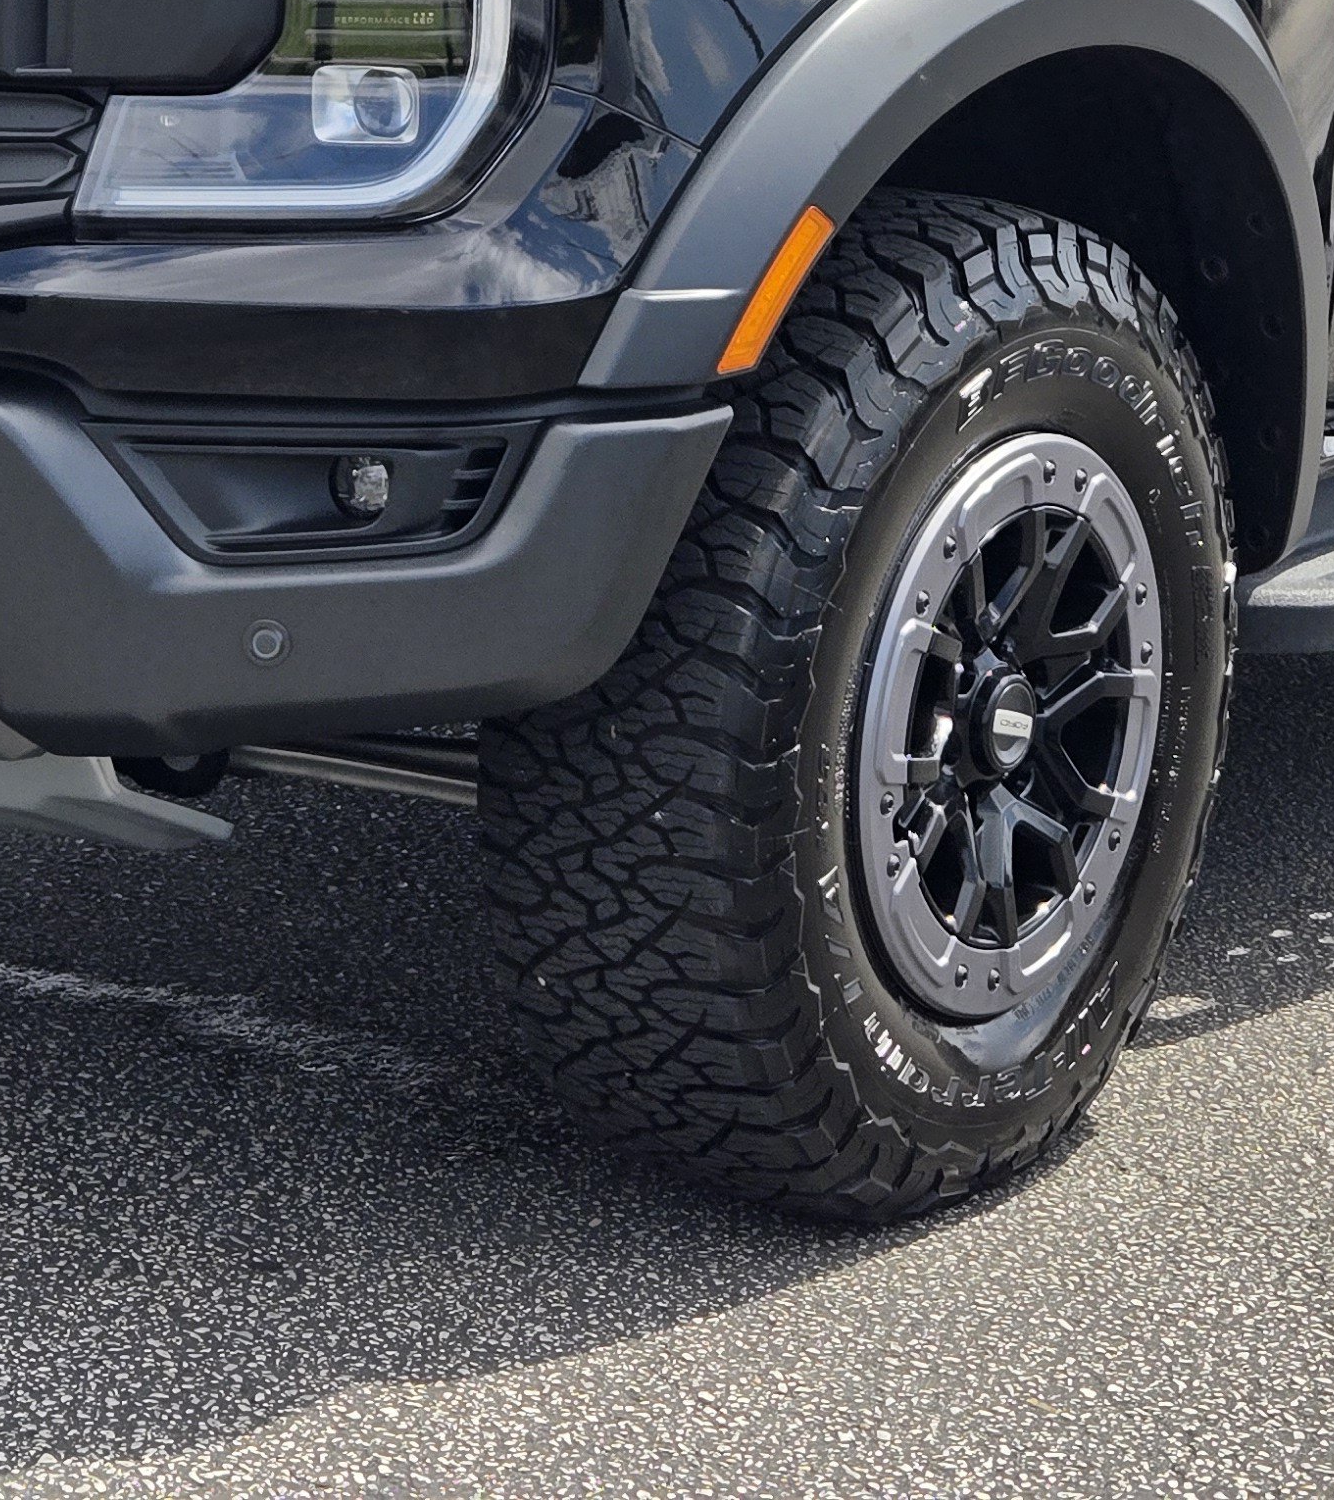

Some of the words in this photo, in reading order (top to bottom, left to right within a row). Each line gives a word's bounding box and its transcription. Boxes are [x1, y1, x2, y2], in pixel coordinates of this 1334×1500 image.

[334, 16, 410, 25] PERFORMANCE
[412, 13, 435, 25] LED
[955, 338, 1206, 550] BFGoodrich
